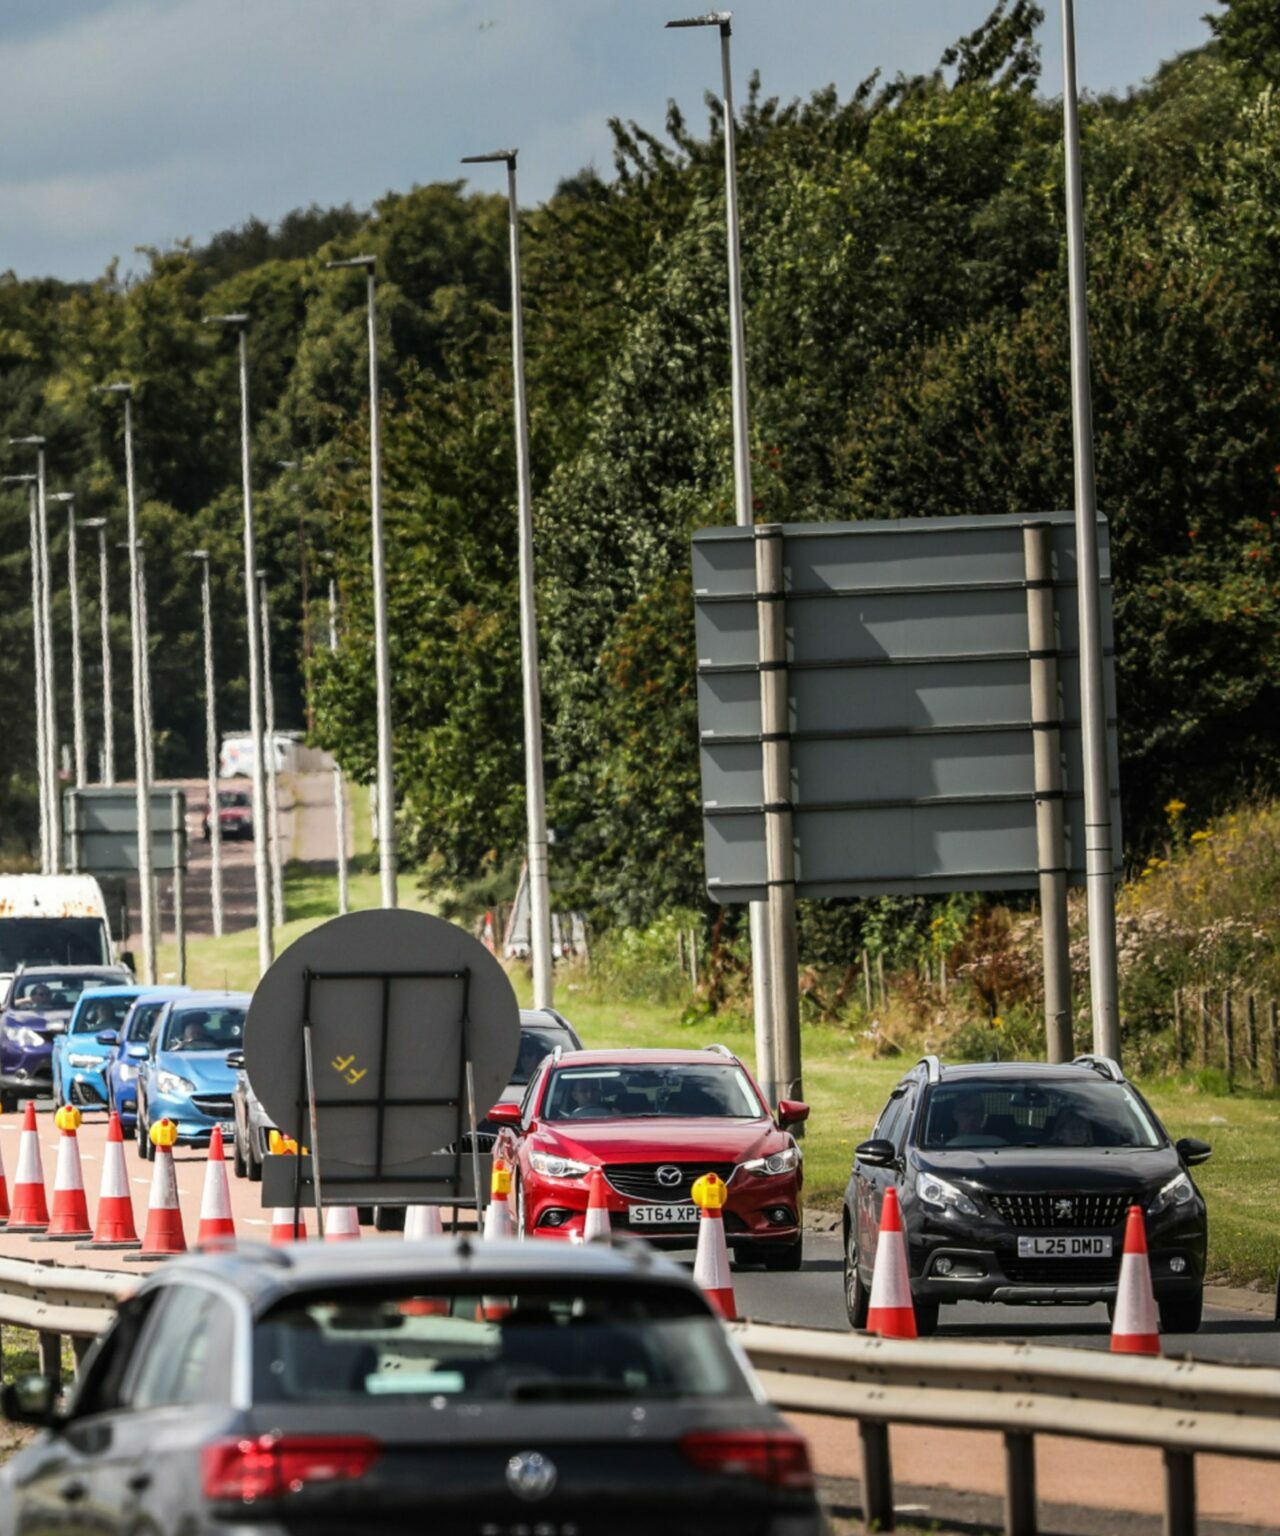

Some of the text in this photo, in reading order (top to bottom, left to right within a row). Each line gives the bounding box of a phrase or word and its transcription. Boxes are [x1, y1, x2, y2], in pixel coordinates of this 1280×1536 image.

[635, 1207, 673, 1221] ST64
[1034, 1239, 1066, 1254] L25
[1071, 1239, 1103, 1254] DMD
